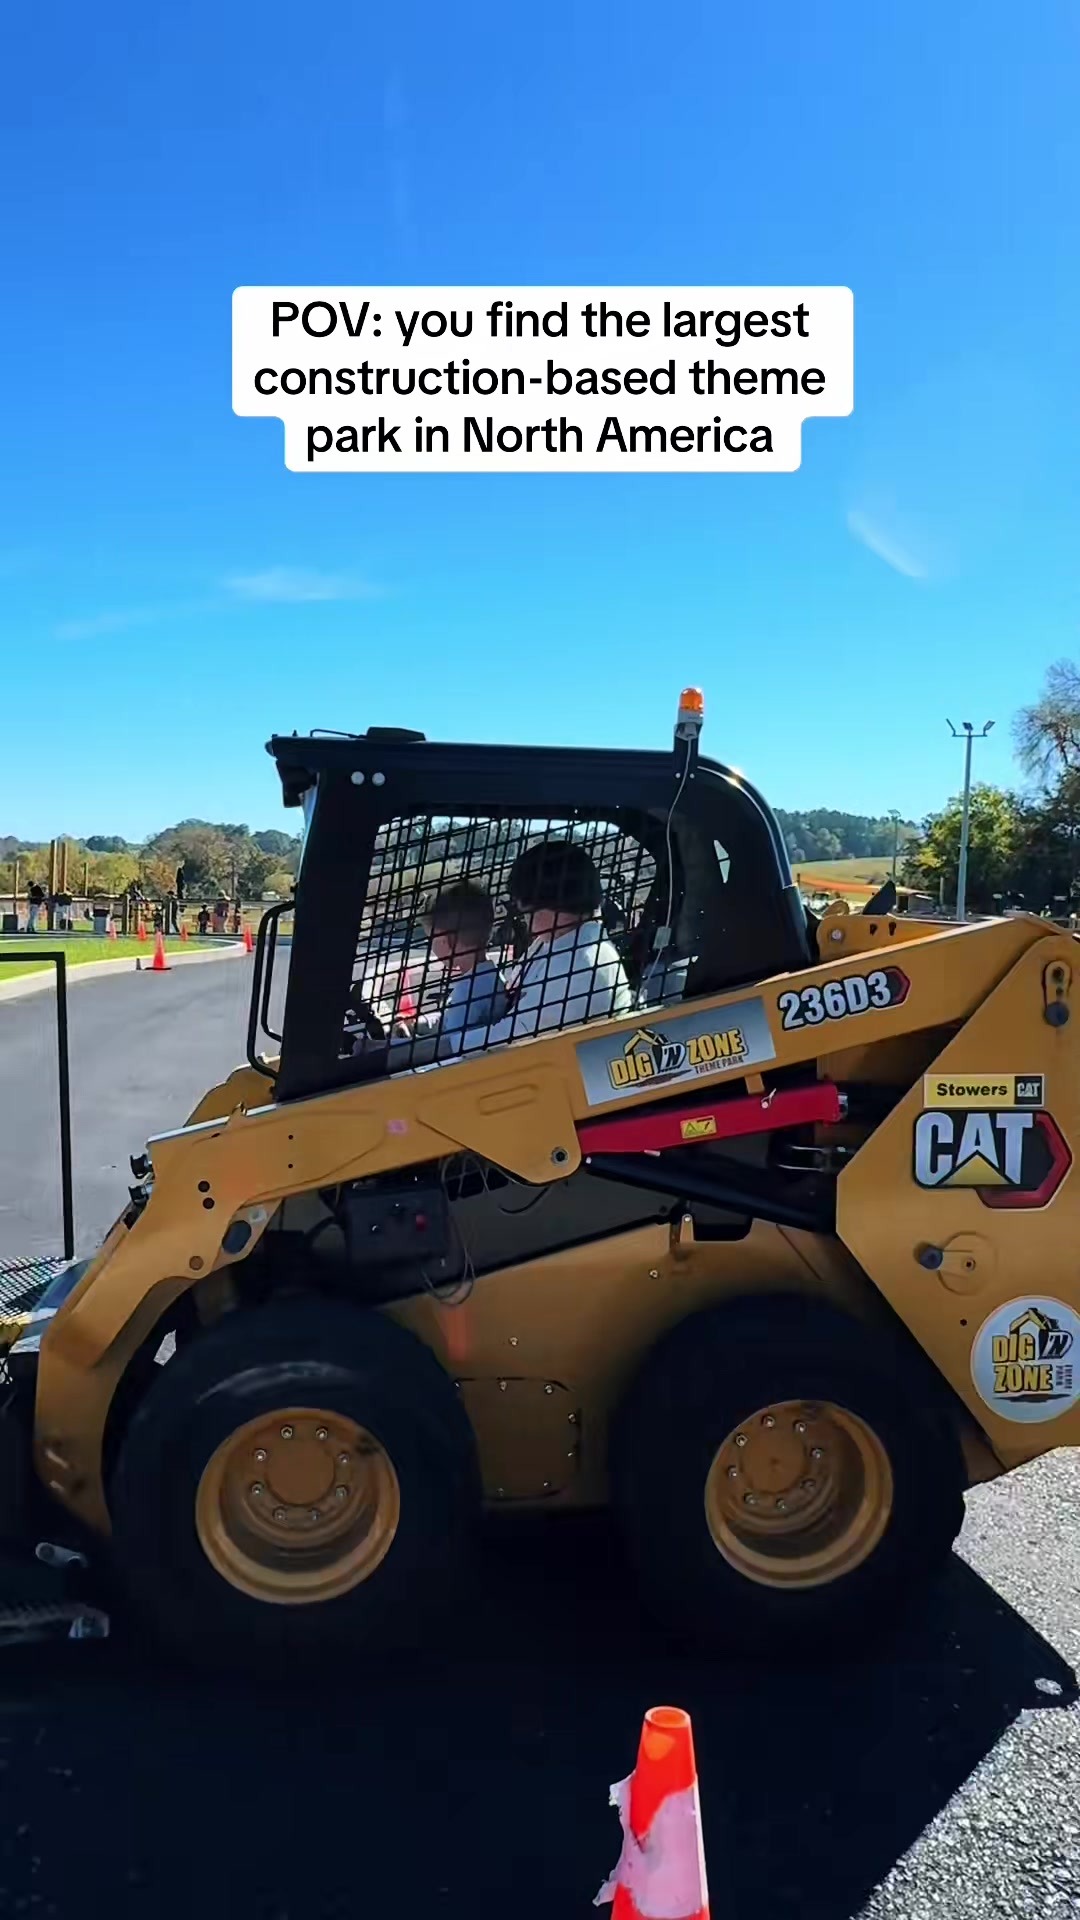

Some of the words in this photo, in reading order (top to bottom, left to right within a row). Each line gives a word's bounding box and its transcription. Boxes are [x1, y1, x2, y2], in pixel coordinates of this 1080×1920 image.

[779, 971, 892, 1030] 236D3
[610, 1052, 655, 1086] DIG
[686, 1029, 745, 1065] ZONE
[694, 1060, 721, 1075] THEME
[722, 1055, 744, 1069] PARK
[936, 1082, 1008, 1097] Stowers
[1016, 1082, 1041, 1098] CAT
[915, 1111, 1034, 1186] CAT
[992, 1333, 1036, 1364] DIG
[993, 1363, 1054, 1393] ZONE
